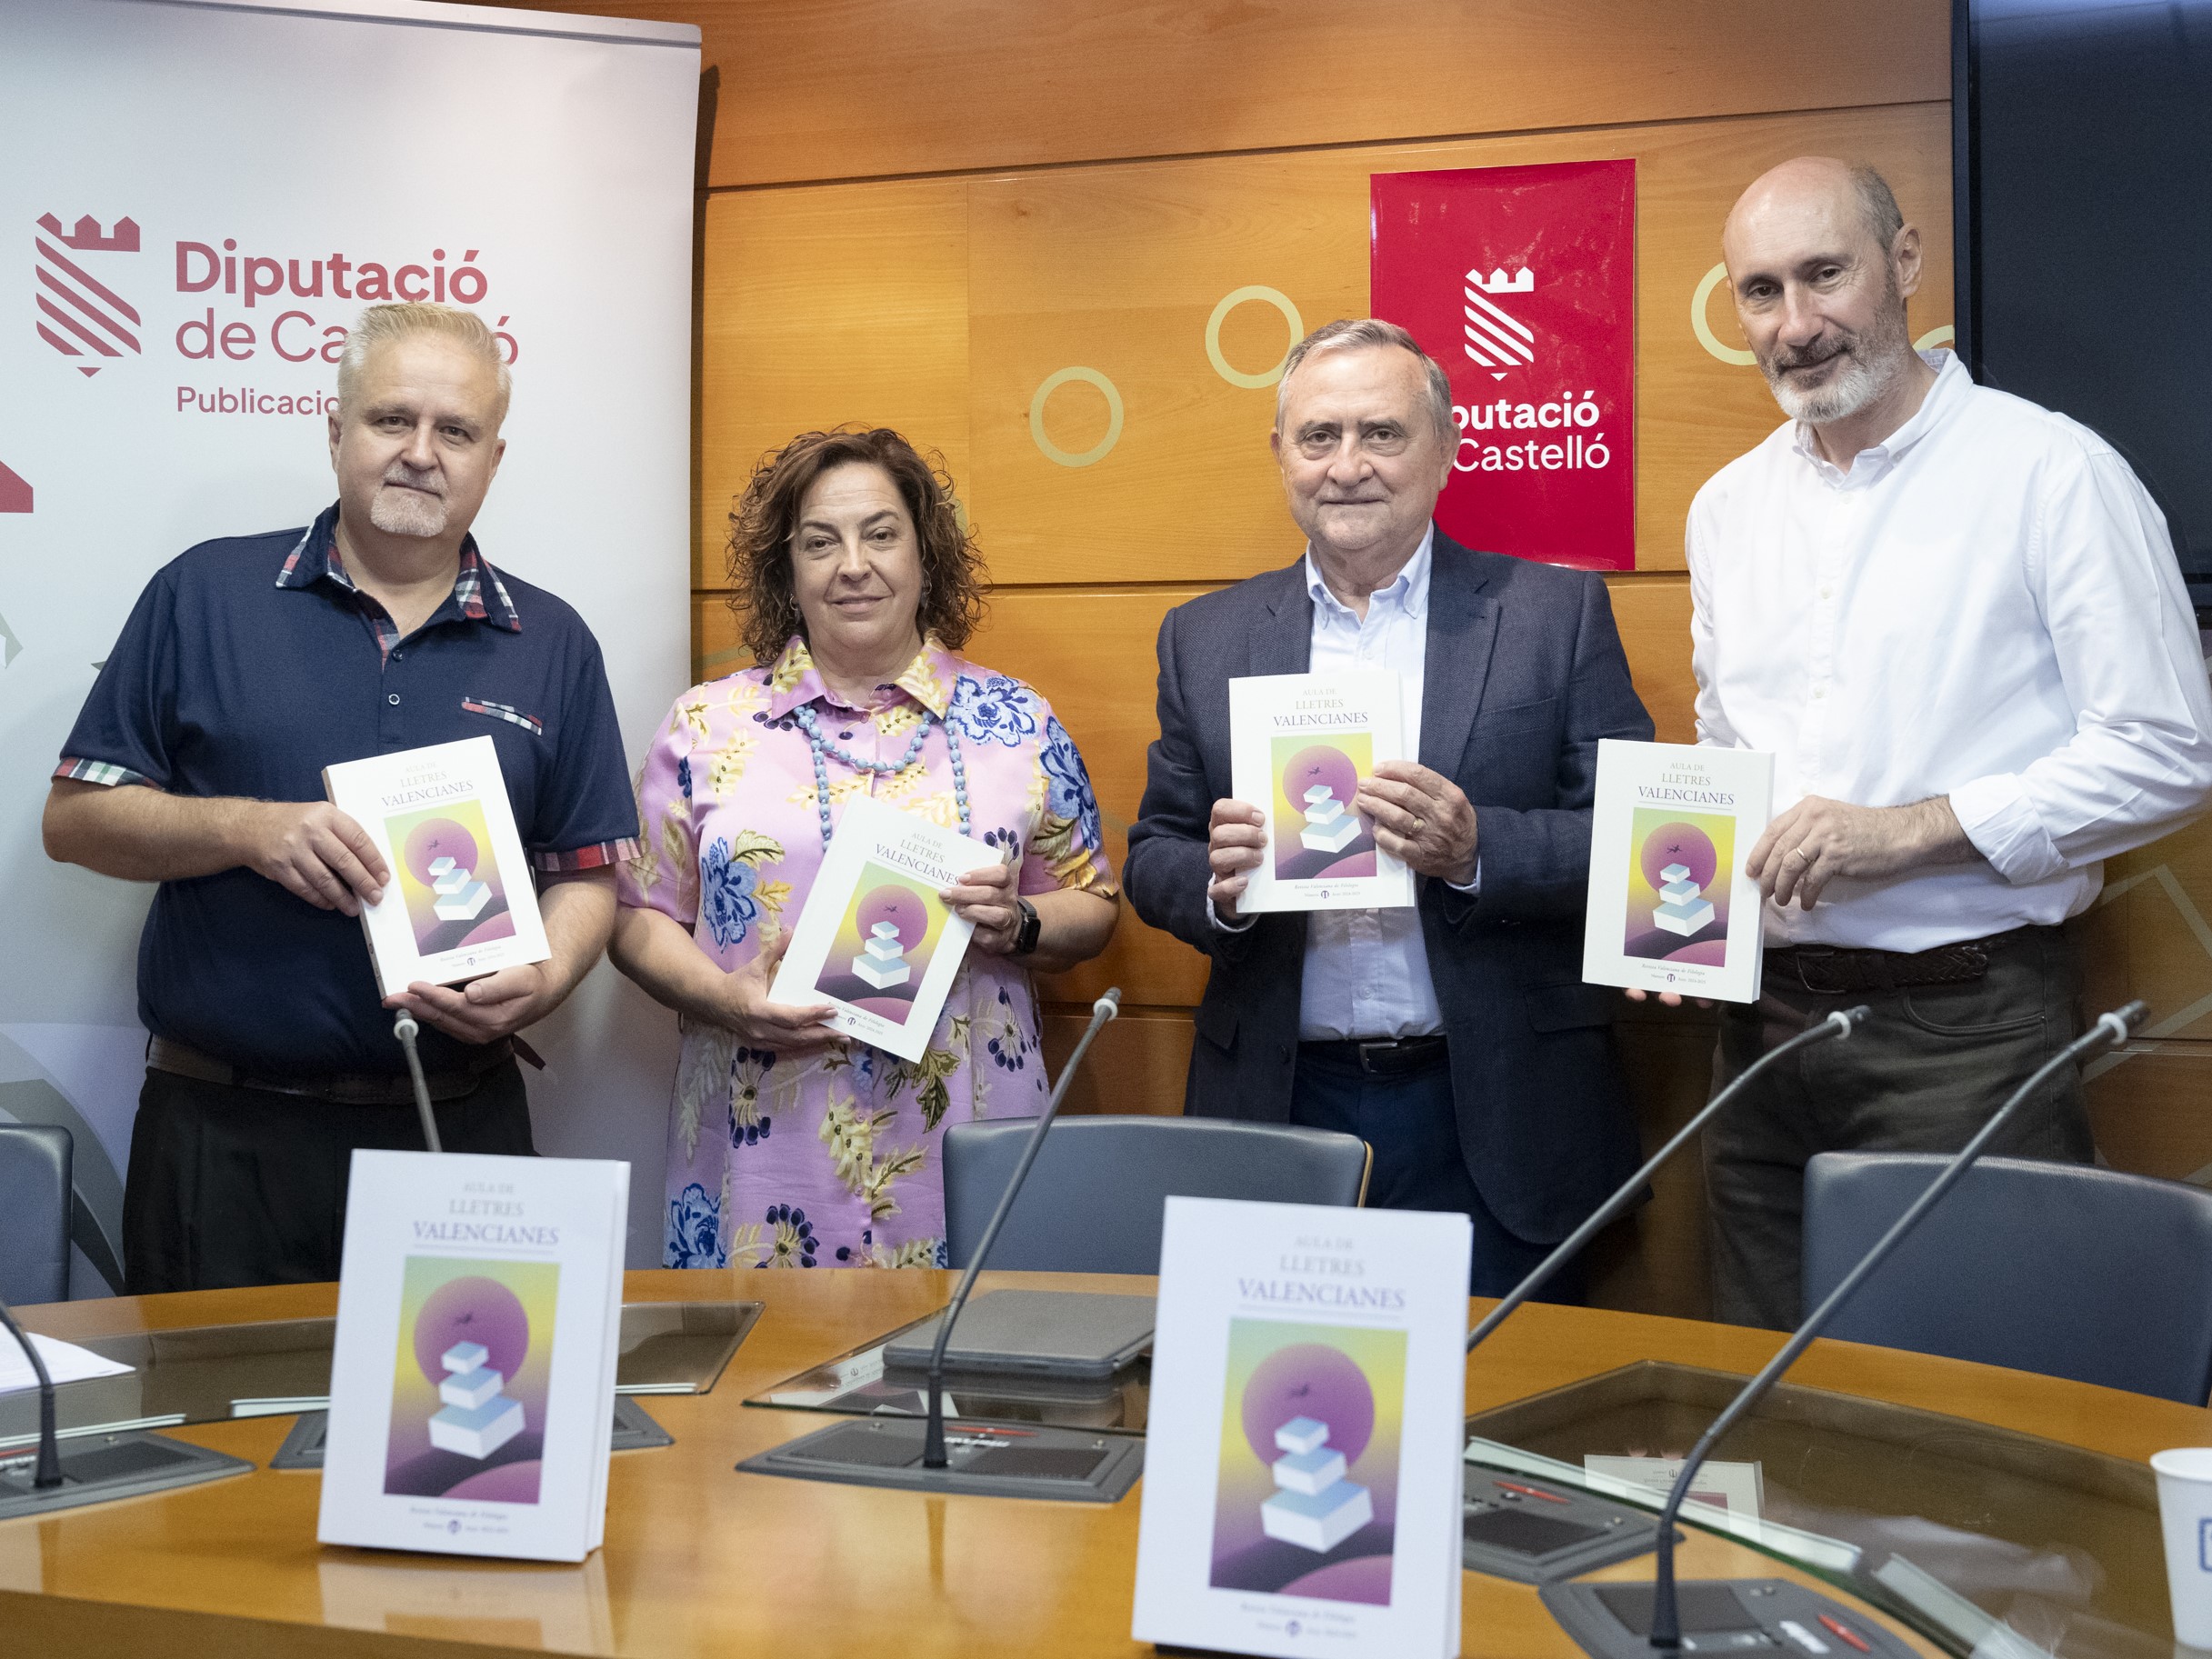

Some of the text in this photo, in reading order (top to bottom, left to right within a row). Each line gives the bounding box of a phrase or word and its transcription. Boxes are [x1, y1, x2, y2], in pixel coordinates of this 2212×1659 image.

[175, 238, 488, 307] Diputació
[175, 307, 257, 361] de
[177, 386, 340, 415] Publicacio
[1453, 433, 1610, 472] Castelló
[1302, 687, 1337, 696] AULA DE
[1296, 698, 1344, 710] LLETRES
[1274, 712, 1368, 726] VALENCIANES
[1669, 762, 1706, 772] AULA DE
[400, 770, 448, 789] LLETRES
[1661, 773, 1711, 786] LLETRES
[381, 779, 475, 807] VALENCIANES
[1638, 785, 1735, 805] VALENCIANES
[900, 838, 945, 864] LLETRES
[911, 832, 943, 849] AULA DE
[876, 844, 960, 886] VALENCIANES
[448, 1199, 525, 1217] LLETRES
[412, 1220, 560, 1246] VALENCIANES
[1278, 1254, 1366, 1276] LLETRES
[1236, 1277, 1406, 1310] VALENCIANES
